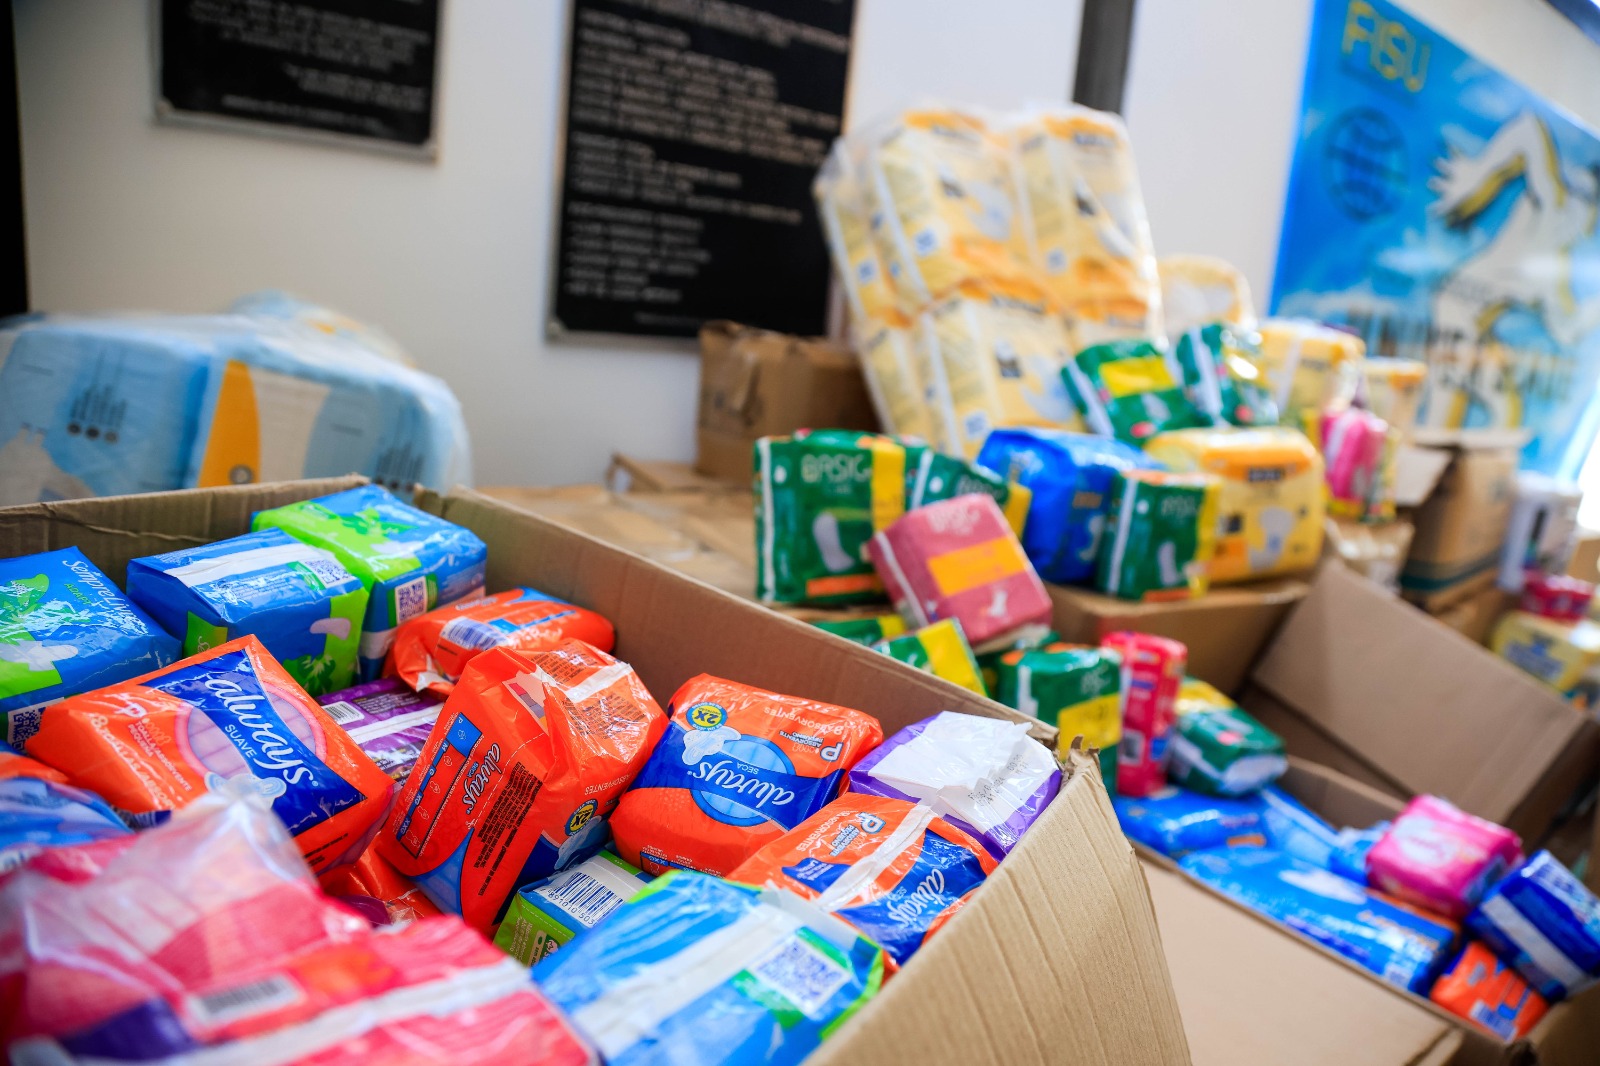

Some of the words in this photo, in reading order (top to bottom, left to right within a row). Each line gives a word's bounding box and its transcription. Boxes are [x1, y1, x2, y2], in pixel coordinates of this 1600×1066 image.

[204, 679, 315, 785] always
[697, 709, 717, 723] 2X
[224, 723, 257, 759] SUAVE
[819, 740, 844, 763] P
[461, 743, 502, 811] always
[692, 760, 796, 809] always
[736, 762, 760, 775] SECA
[887, 867, 946, 923] always
